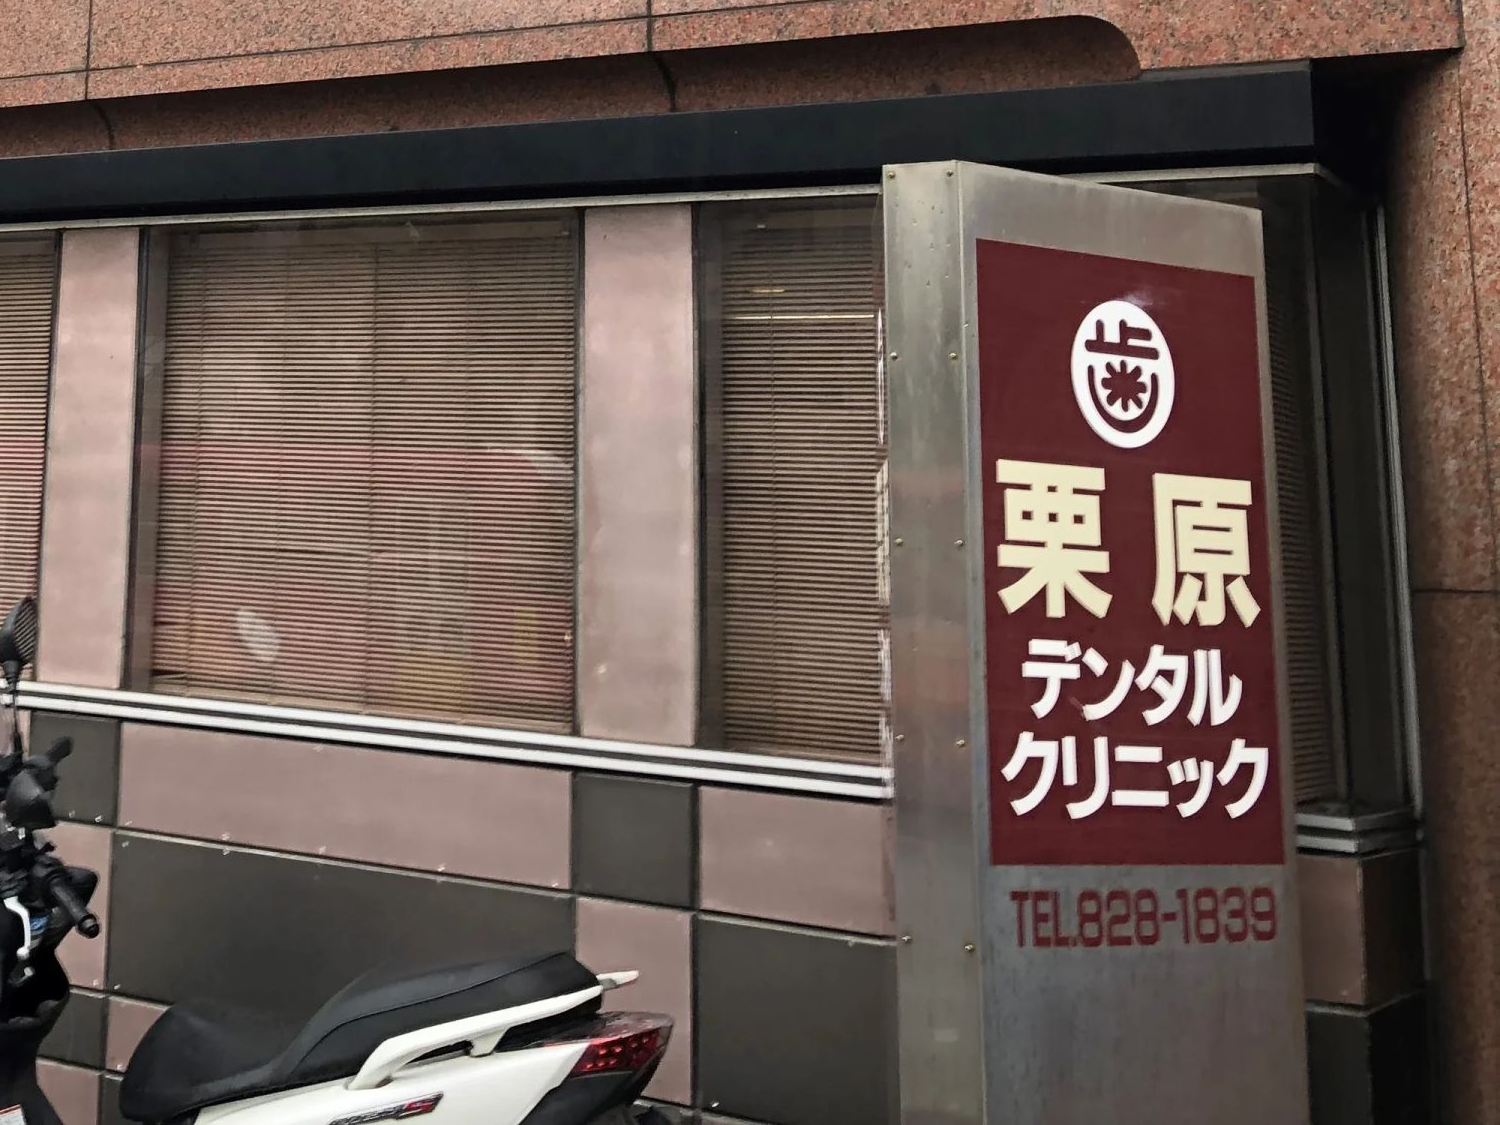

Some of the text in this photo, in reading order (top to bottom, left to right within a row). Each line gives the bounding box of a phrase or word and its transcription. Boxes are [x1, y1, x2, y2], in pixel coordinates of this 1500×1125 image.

[995, 458, 1262, 628] 栗原
[1021, 638, 1244, 727] デンタル
[1001, 730, 1270, 822] クリニック
[1011, 887, 1279, 950] TEL.828-1839
